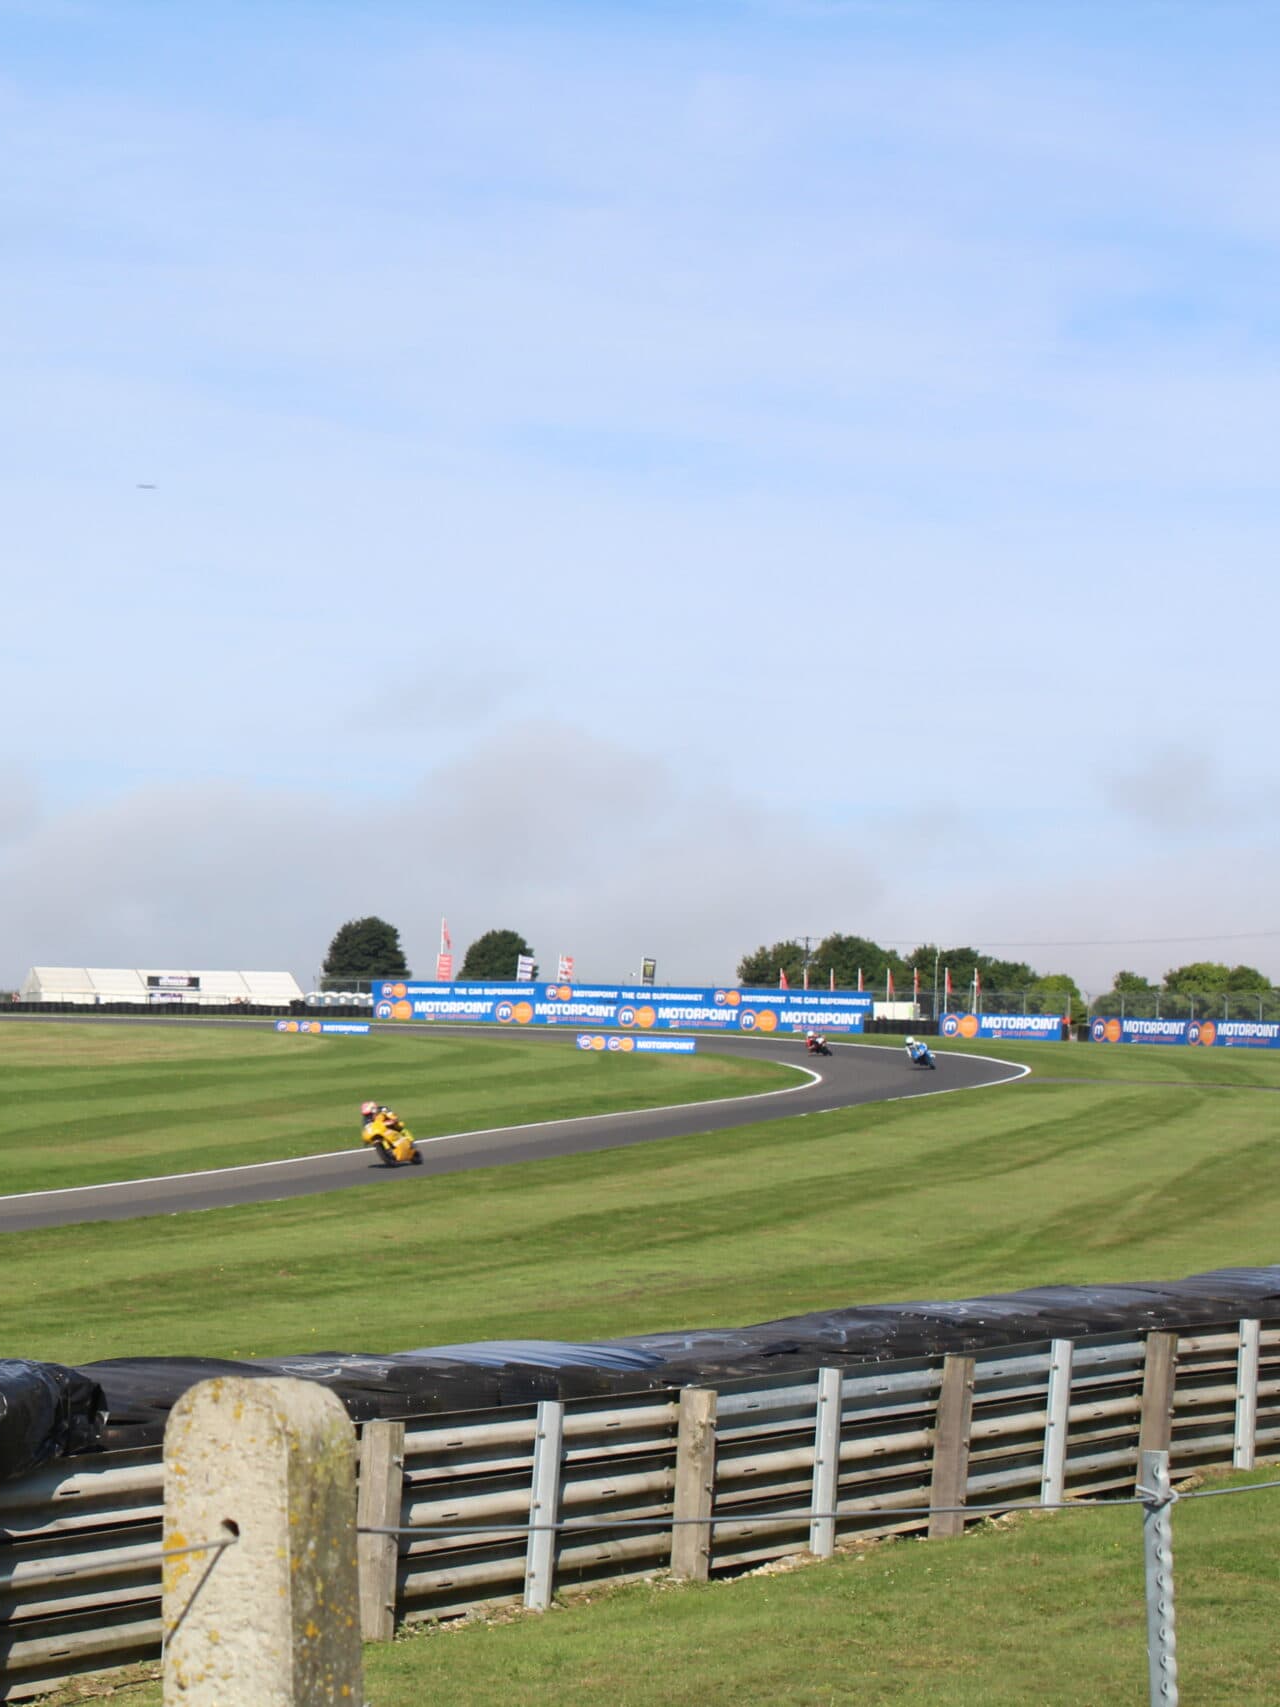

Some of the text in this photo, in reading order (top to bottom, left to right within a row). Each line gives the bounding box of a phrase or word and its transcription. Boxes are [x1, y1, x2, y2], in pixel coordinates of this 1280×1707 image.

[573, 990, 618, 998] MOTORPOINT
[636, 992, 651, 1000] CAR
[652, 992, 703, 1001] SUPERMARKET
[741, 995, 786, 1003] MOTORPOINT
[790, 996, 803, 1004] THE
[820, 997, 871, 1006] SUPERMARKET
[414, 1001, 493, 1013] MOTORPOINT
[535, 1003, 616, 1017] MOTORPOINT
[658, 1007, 738, 1021] MOTORPOINT
[780, 1011, 862, 1025] MOTORPOINT
[981, 1016, 1060, 1030] MOTORPOINT
[1123, 1020, 1185, 1035] MOTORPOINT
[1217, 1023, 1279, 1038] MOTORPOINT
[637, 1040, 696, 1050] MOTORPOINT
